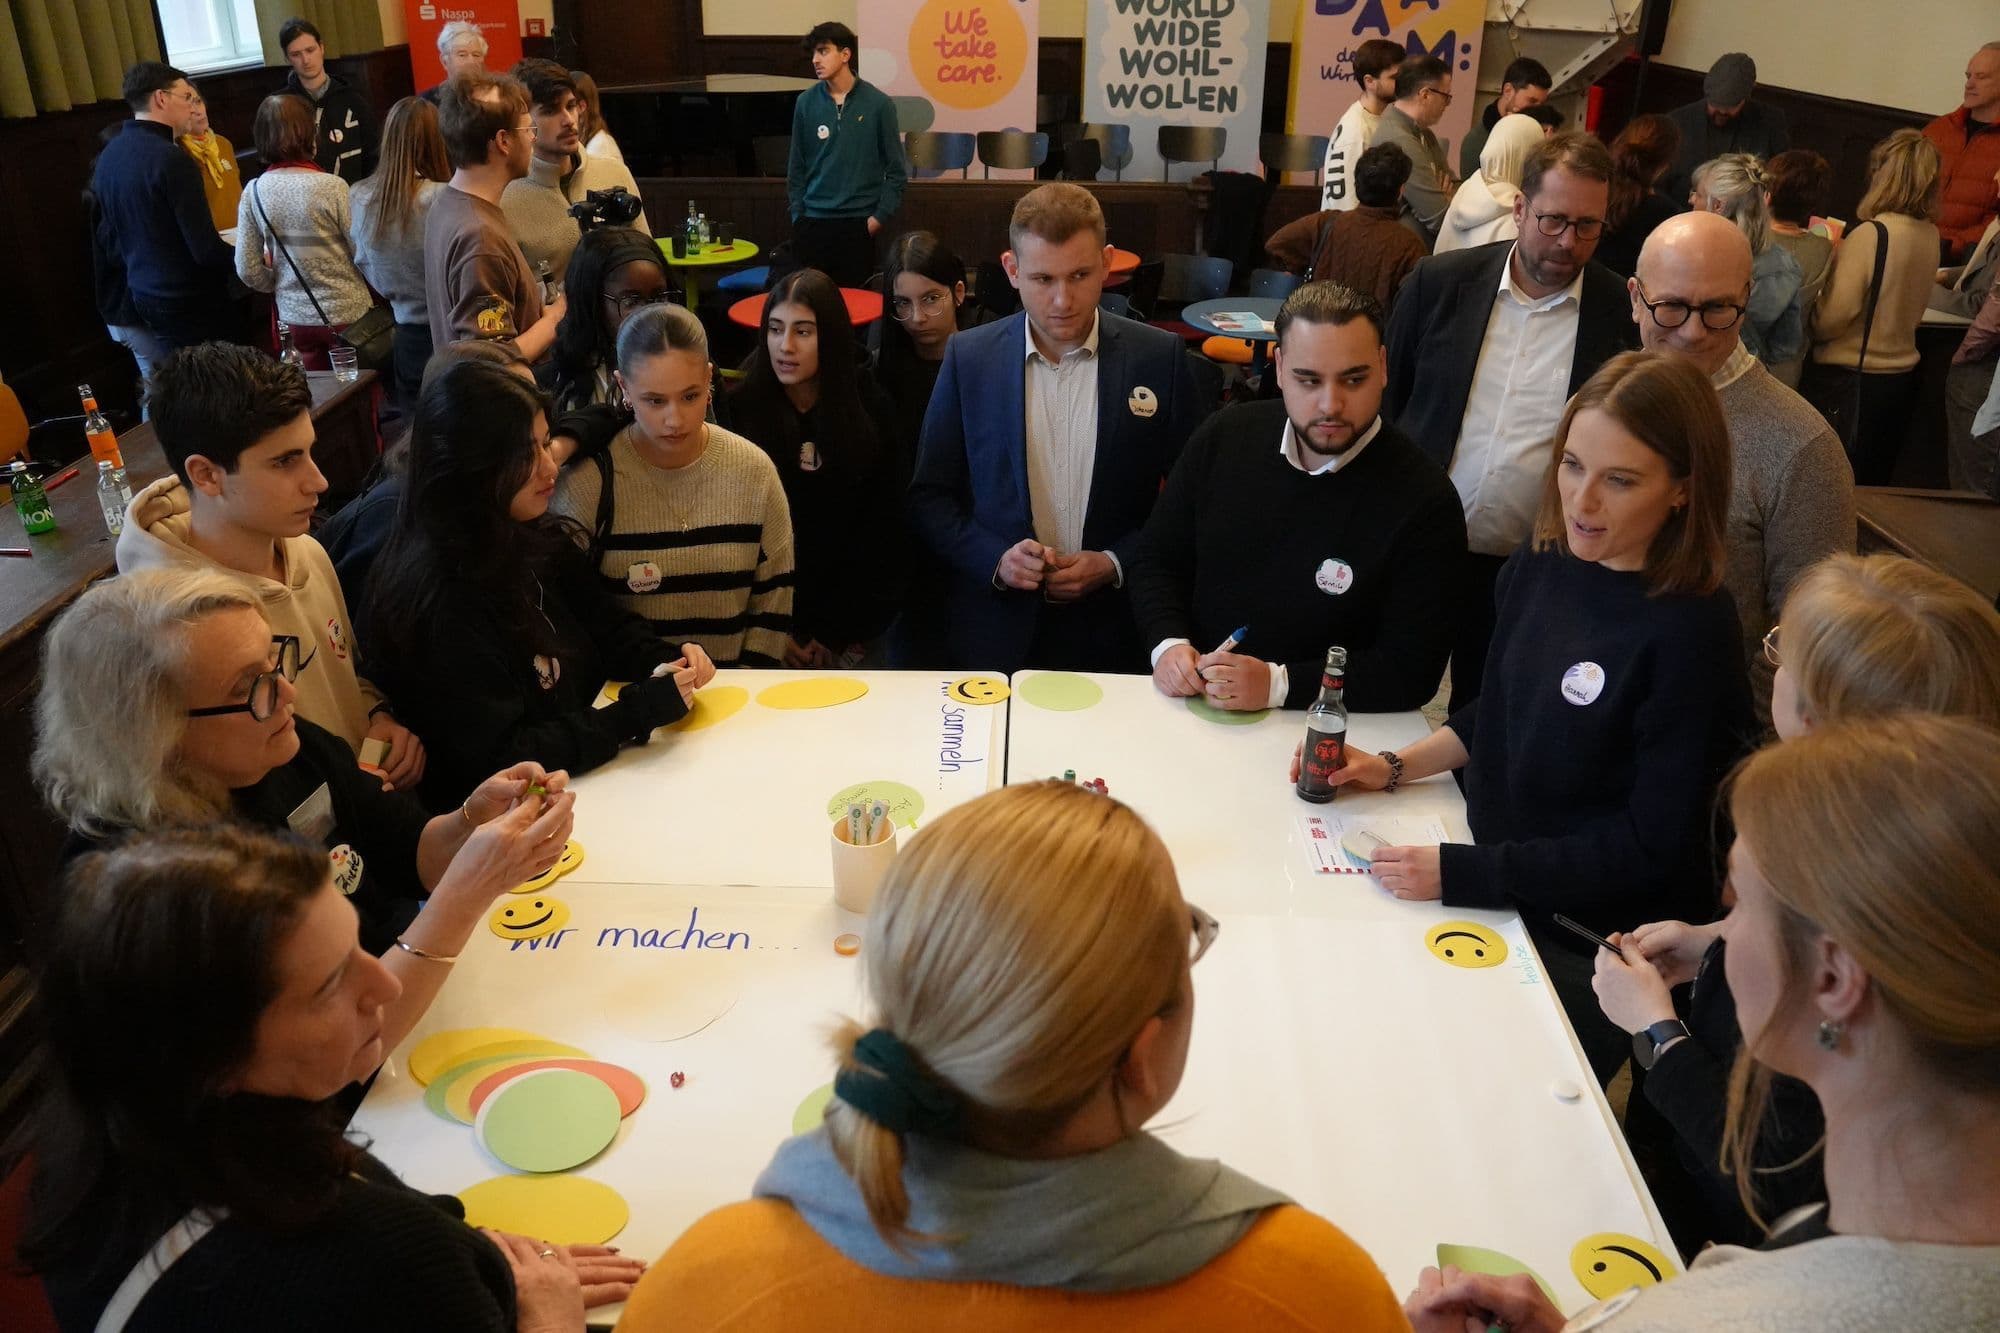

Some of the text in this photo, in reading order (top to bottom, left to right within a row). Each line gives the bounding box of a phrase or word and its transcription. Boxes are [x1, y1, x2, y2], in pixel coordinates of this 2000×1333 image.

[441, 9, 476, 22] Naspa
[944, 7, 988, 36] We
[1115, 0, 1235, 19] WORLD
[933, 33, 997, 59] take
[1133, 18, 1222, 48] WIDE
[937, 63, 1002, 84] care.
[1119, 47, 1233, 78] WOHL-
[1106, 77, 1238, 113] WOLLEN
